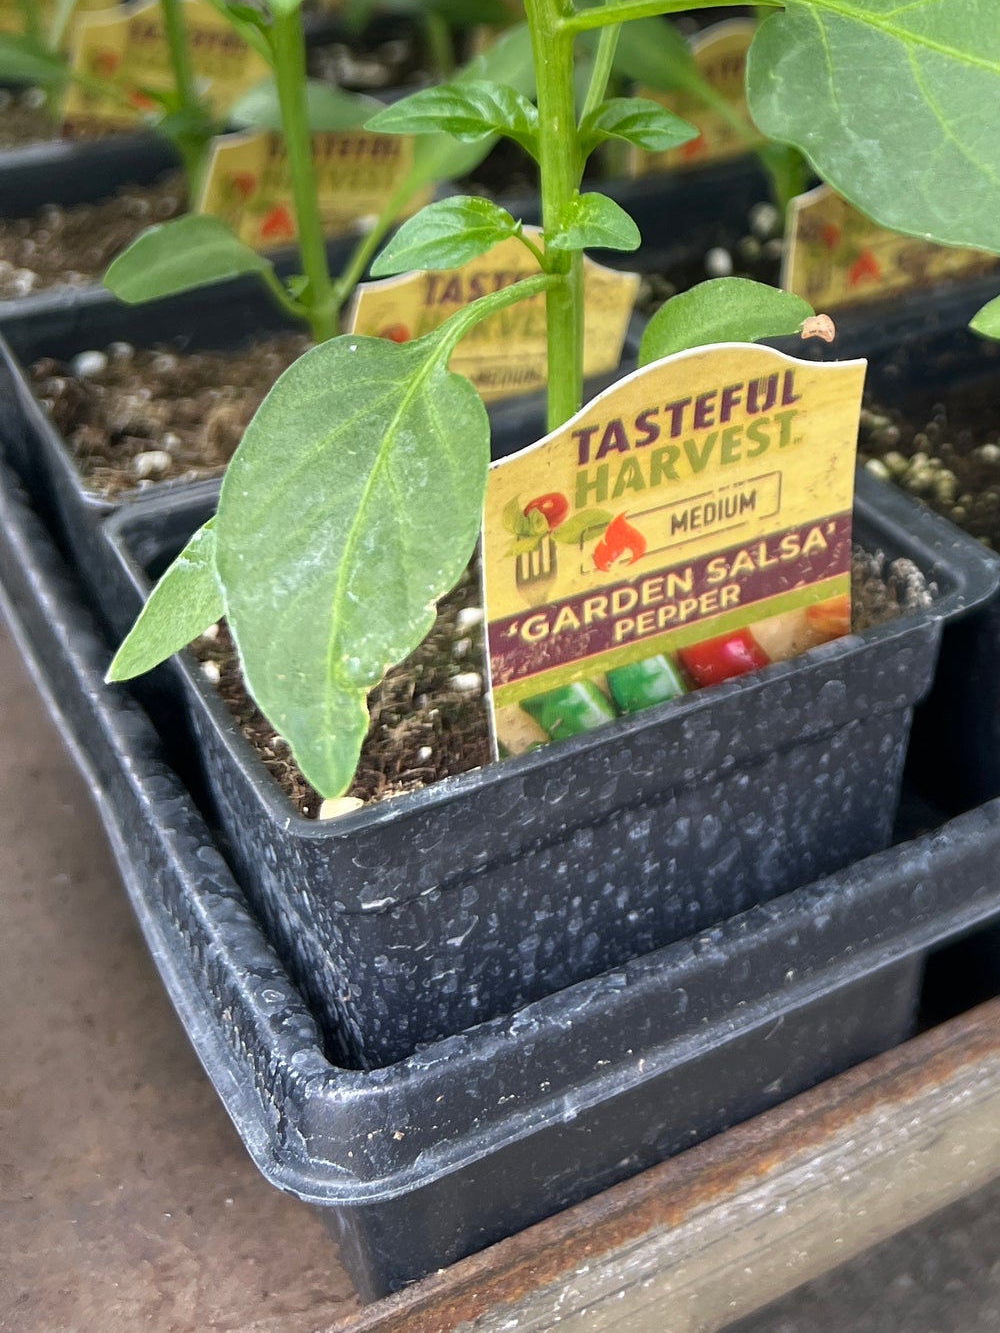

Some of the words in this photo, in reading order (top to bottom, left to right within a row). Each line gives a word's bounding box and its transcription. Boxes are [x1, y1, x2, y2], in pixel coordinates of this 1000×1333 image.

[572, 368, 802, 466] TASTEFUL
[574, 409, 799, 509] HARVEST
[670, 489, 757, 535] MEDIUM
[507, 567, 693, 642] 'GARDEN
[707, 522, 835, 580] SALSA'
[614, 585, 740, 642] PEPPER
